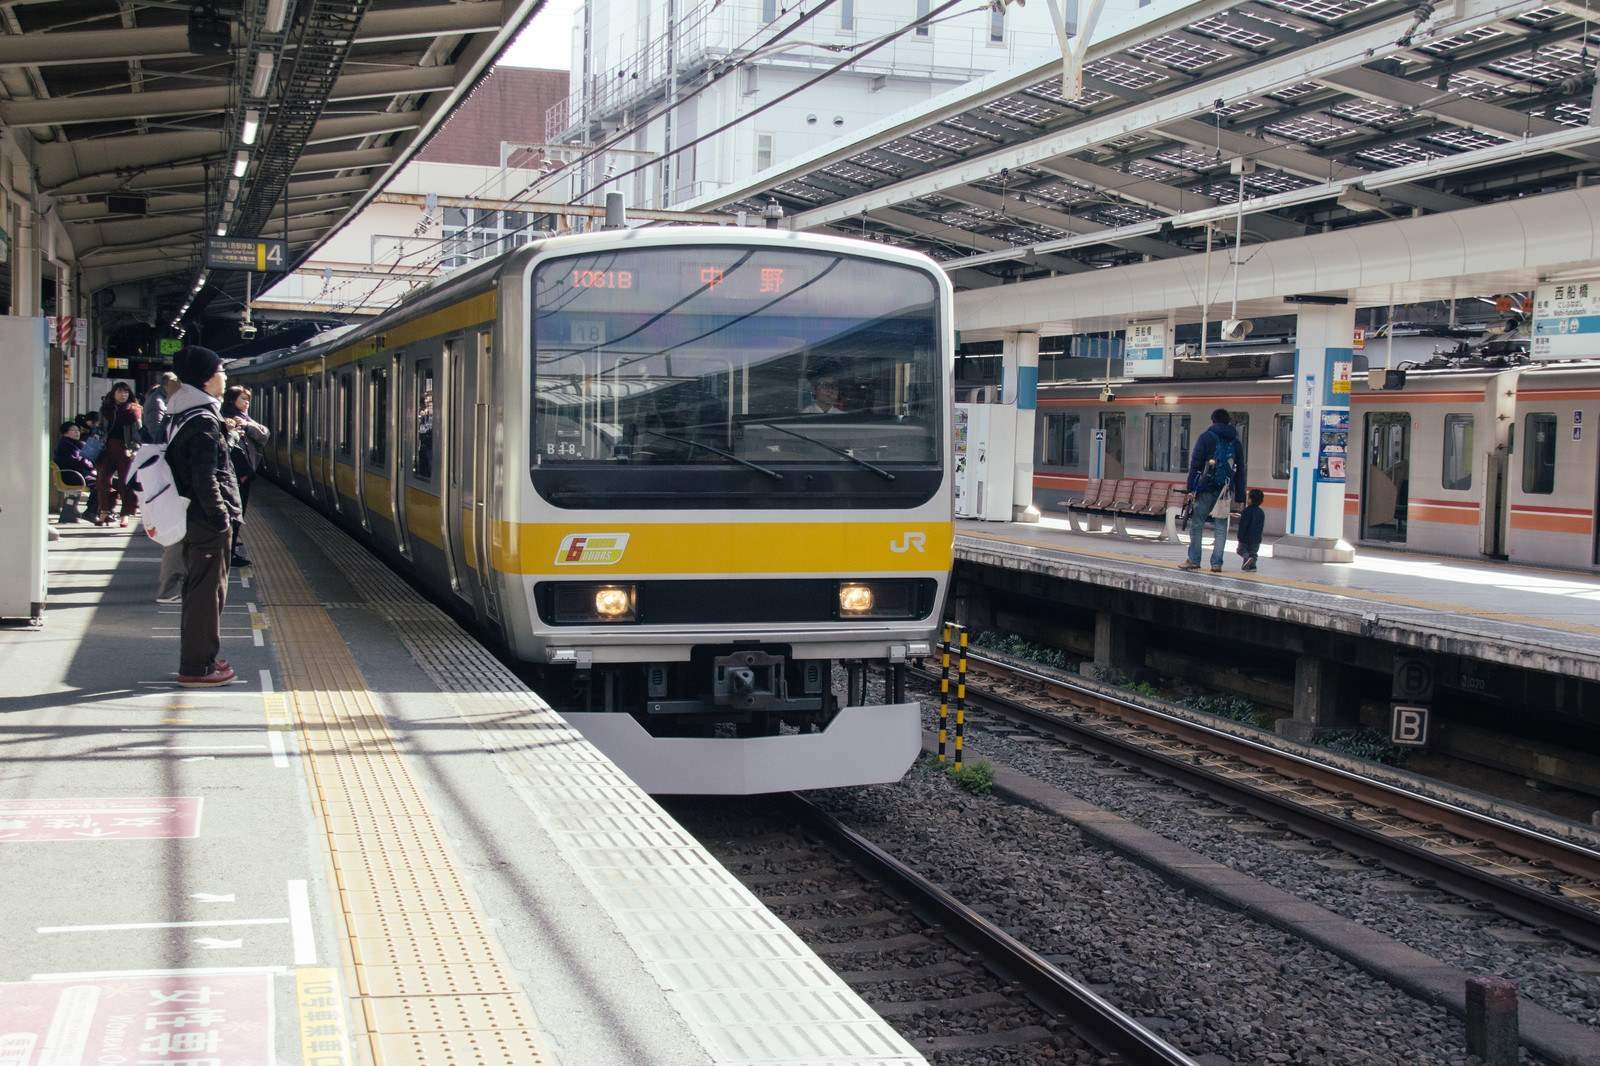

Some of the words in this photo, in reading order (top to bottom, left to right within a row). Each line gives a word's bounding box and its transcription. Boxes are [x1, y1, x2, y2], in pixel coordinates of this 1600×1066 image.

[267, 244, 283, 266] 4
[890, 531, 927, 554] JR
[1399, 711, 1420, 740] B
